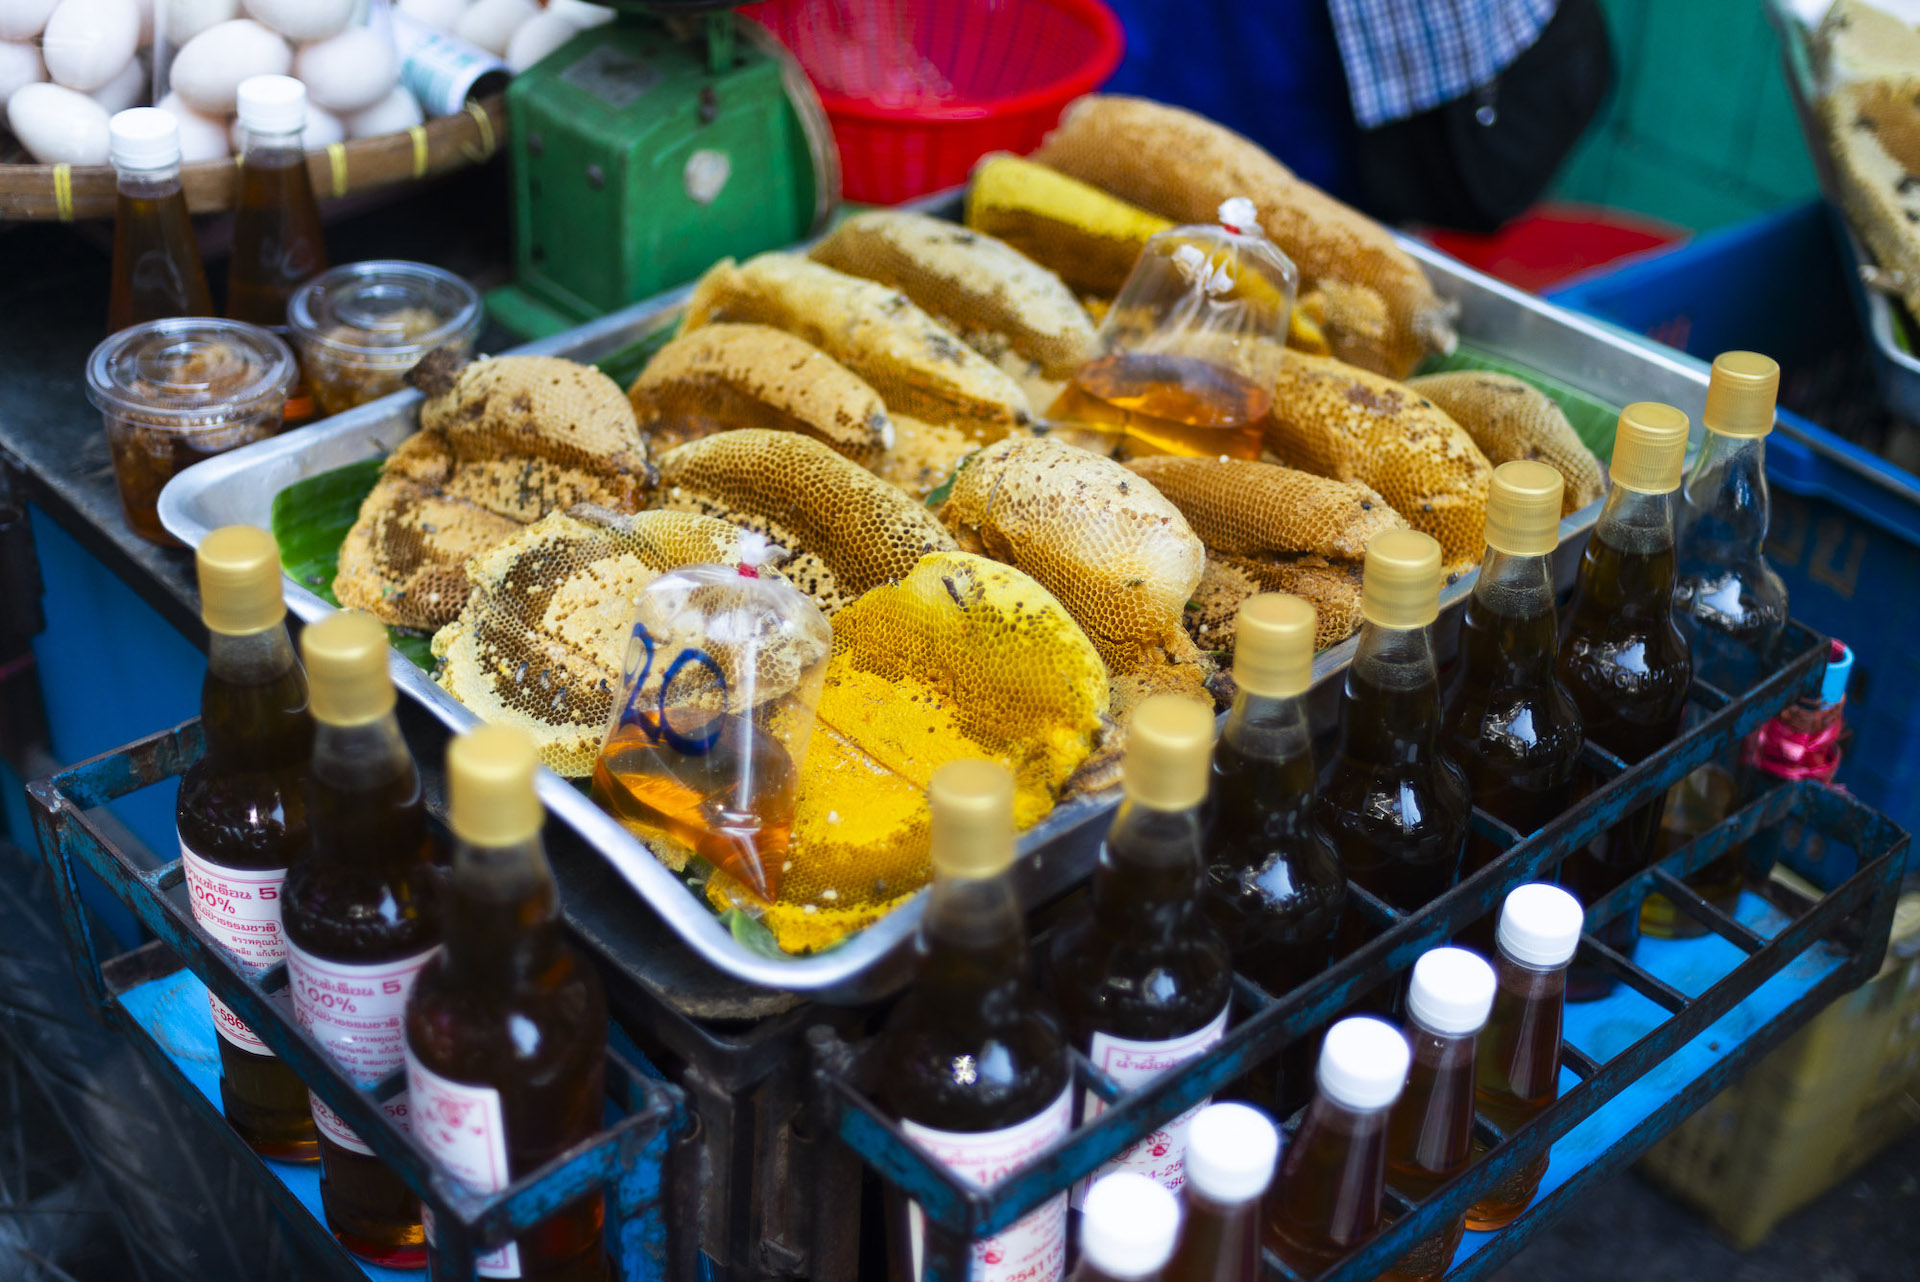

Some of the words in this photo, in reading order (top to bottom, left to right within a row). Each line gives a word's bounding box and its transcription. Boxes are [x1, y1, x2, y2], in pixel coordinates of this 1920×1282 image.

[187, 876, 236, 914] 100%
[258, 887, 278, 900] 5
[298, 980, 357, 1013] 100%
[382, 980, 402, 994] 5
